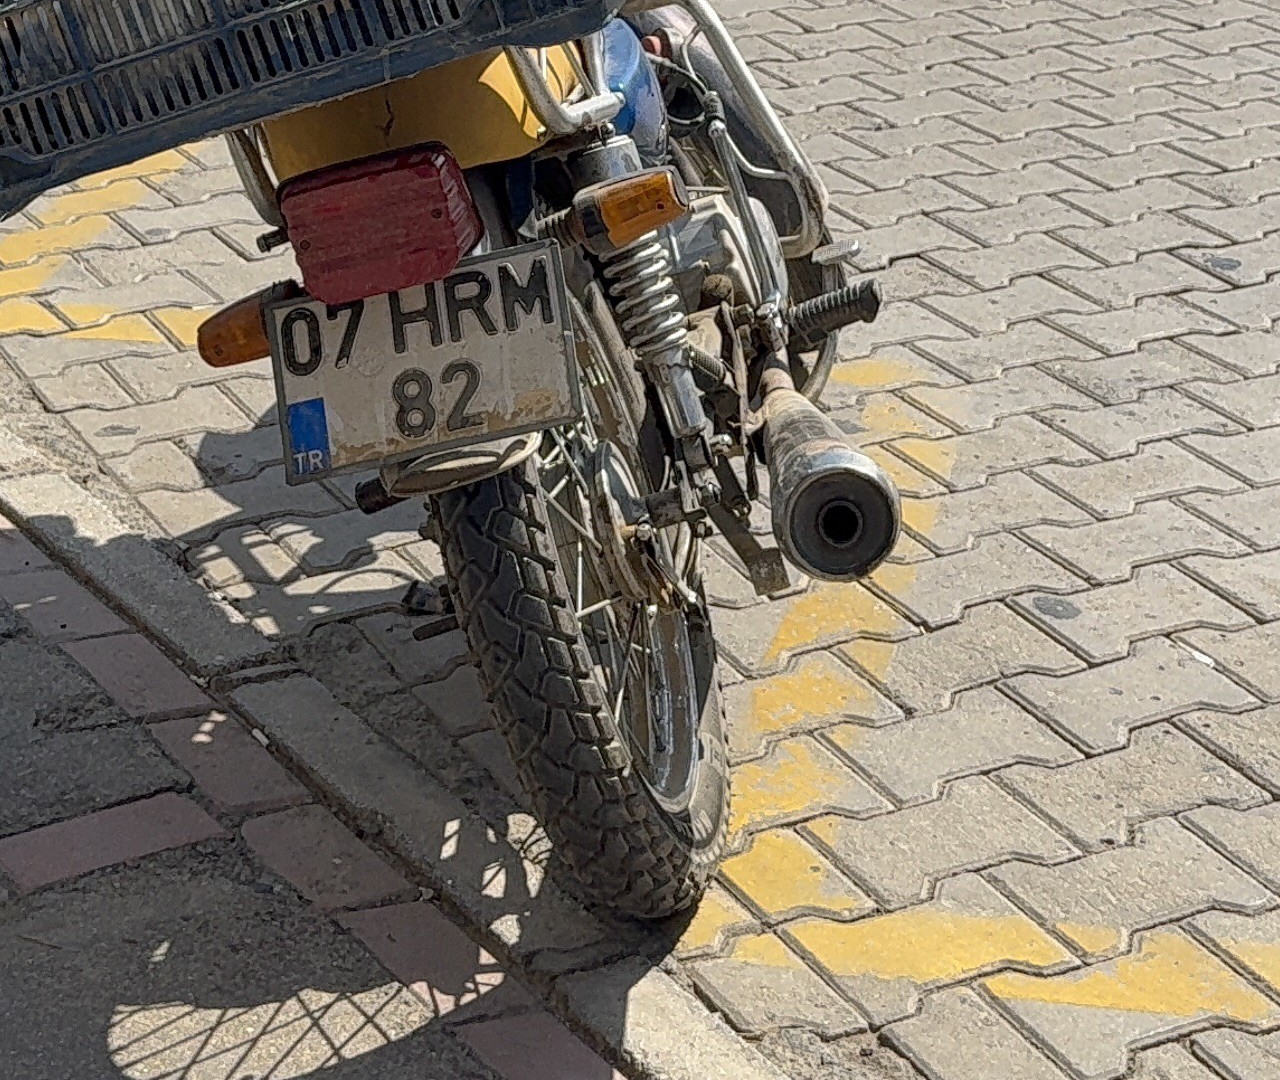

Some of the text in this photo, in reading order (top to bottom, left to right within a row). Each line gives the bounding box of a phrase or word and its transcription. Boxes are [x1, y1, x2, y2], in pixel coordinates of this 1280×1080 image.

[281, 254, 554, 377] 07 HRM
[392, 359, 485, 438] 82
[293, 450, 325, 474] TR
